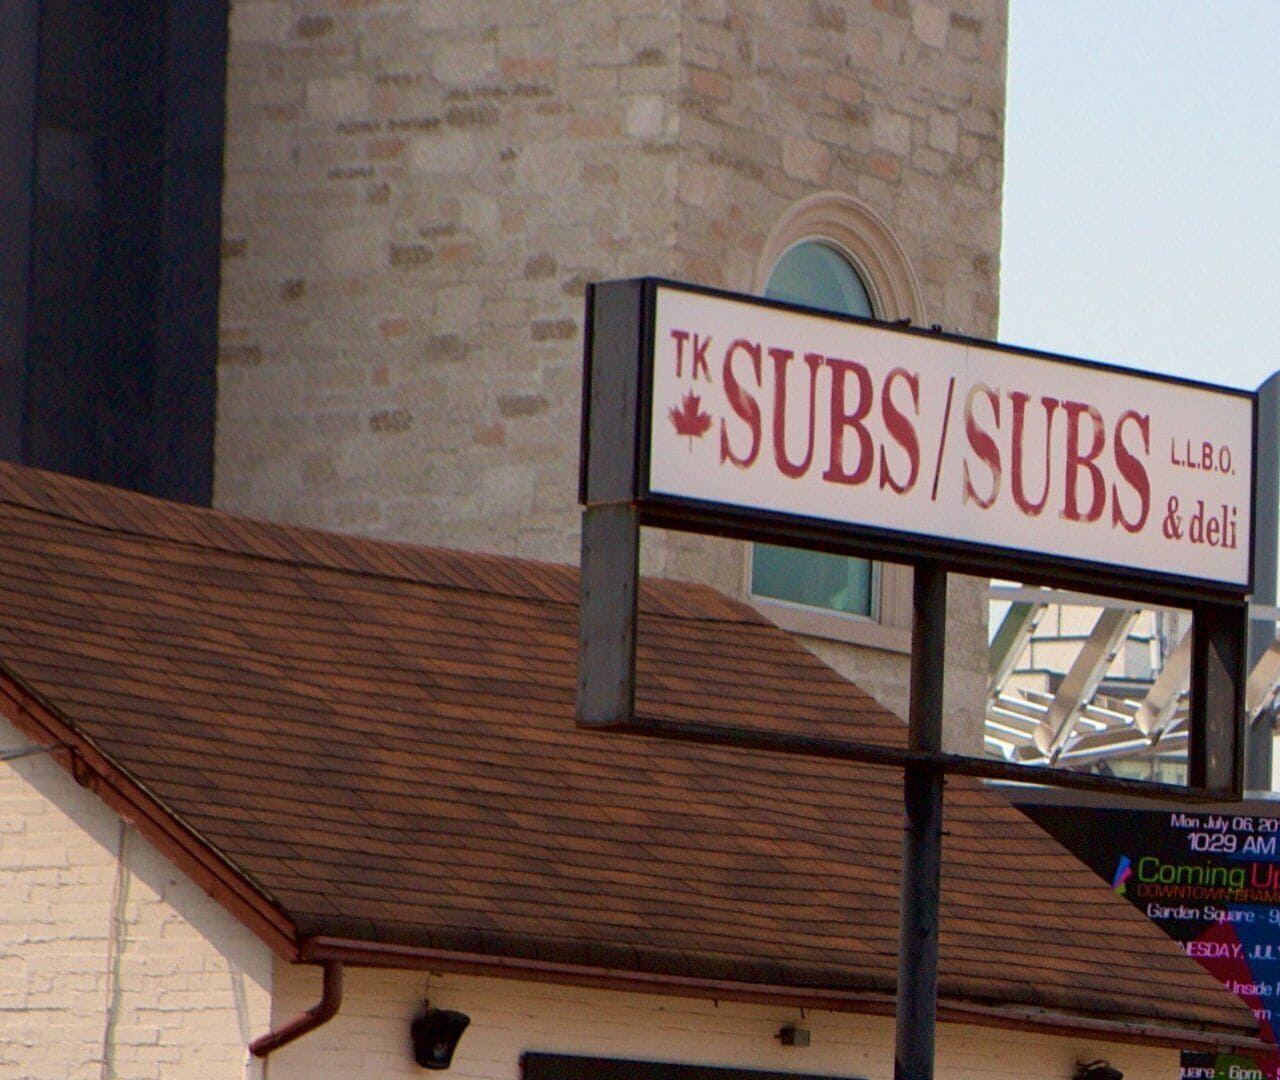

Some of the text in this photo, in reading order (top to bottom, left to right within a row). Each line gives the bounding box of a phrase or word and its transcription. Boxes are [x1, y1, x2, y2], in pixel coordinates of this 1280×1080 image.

[670, 329, 713, 383] TK
[1162, 496, 1237, 550] & deli
[1170, 813, 1199, 830] Mon
[1203, 815, 1229, 834] July
[1242, 836, 1276, 855] AM
[1138, 857, 1245, 889] Coming
[1137, 884, 1231, 901] DOWNTOWN
[1147, 903, 1199, 921] Garden
[1204, 905, 1254, 924] Square
[1233, 980, 1272, 997] Inside
